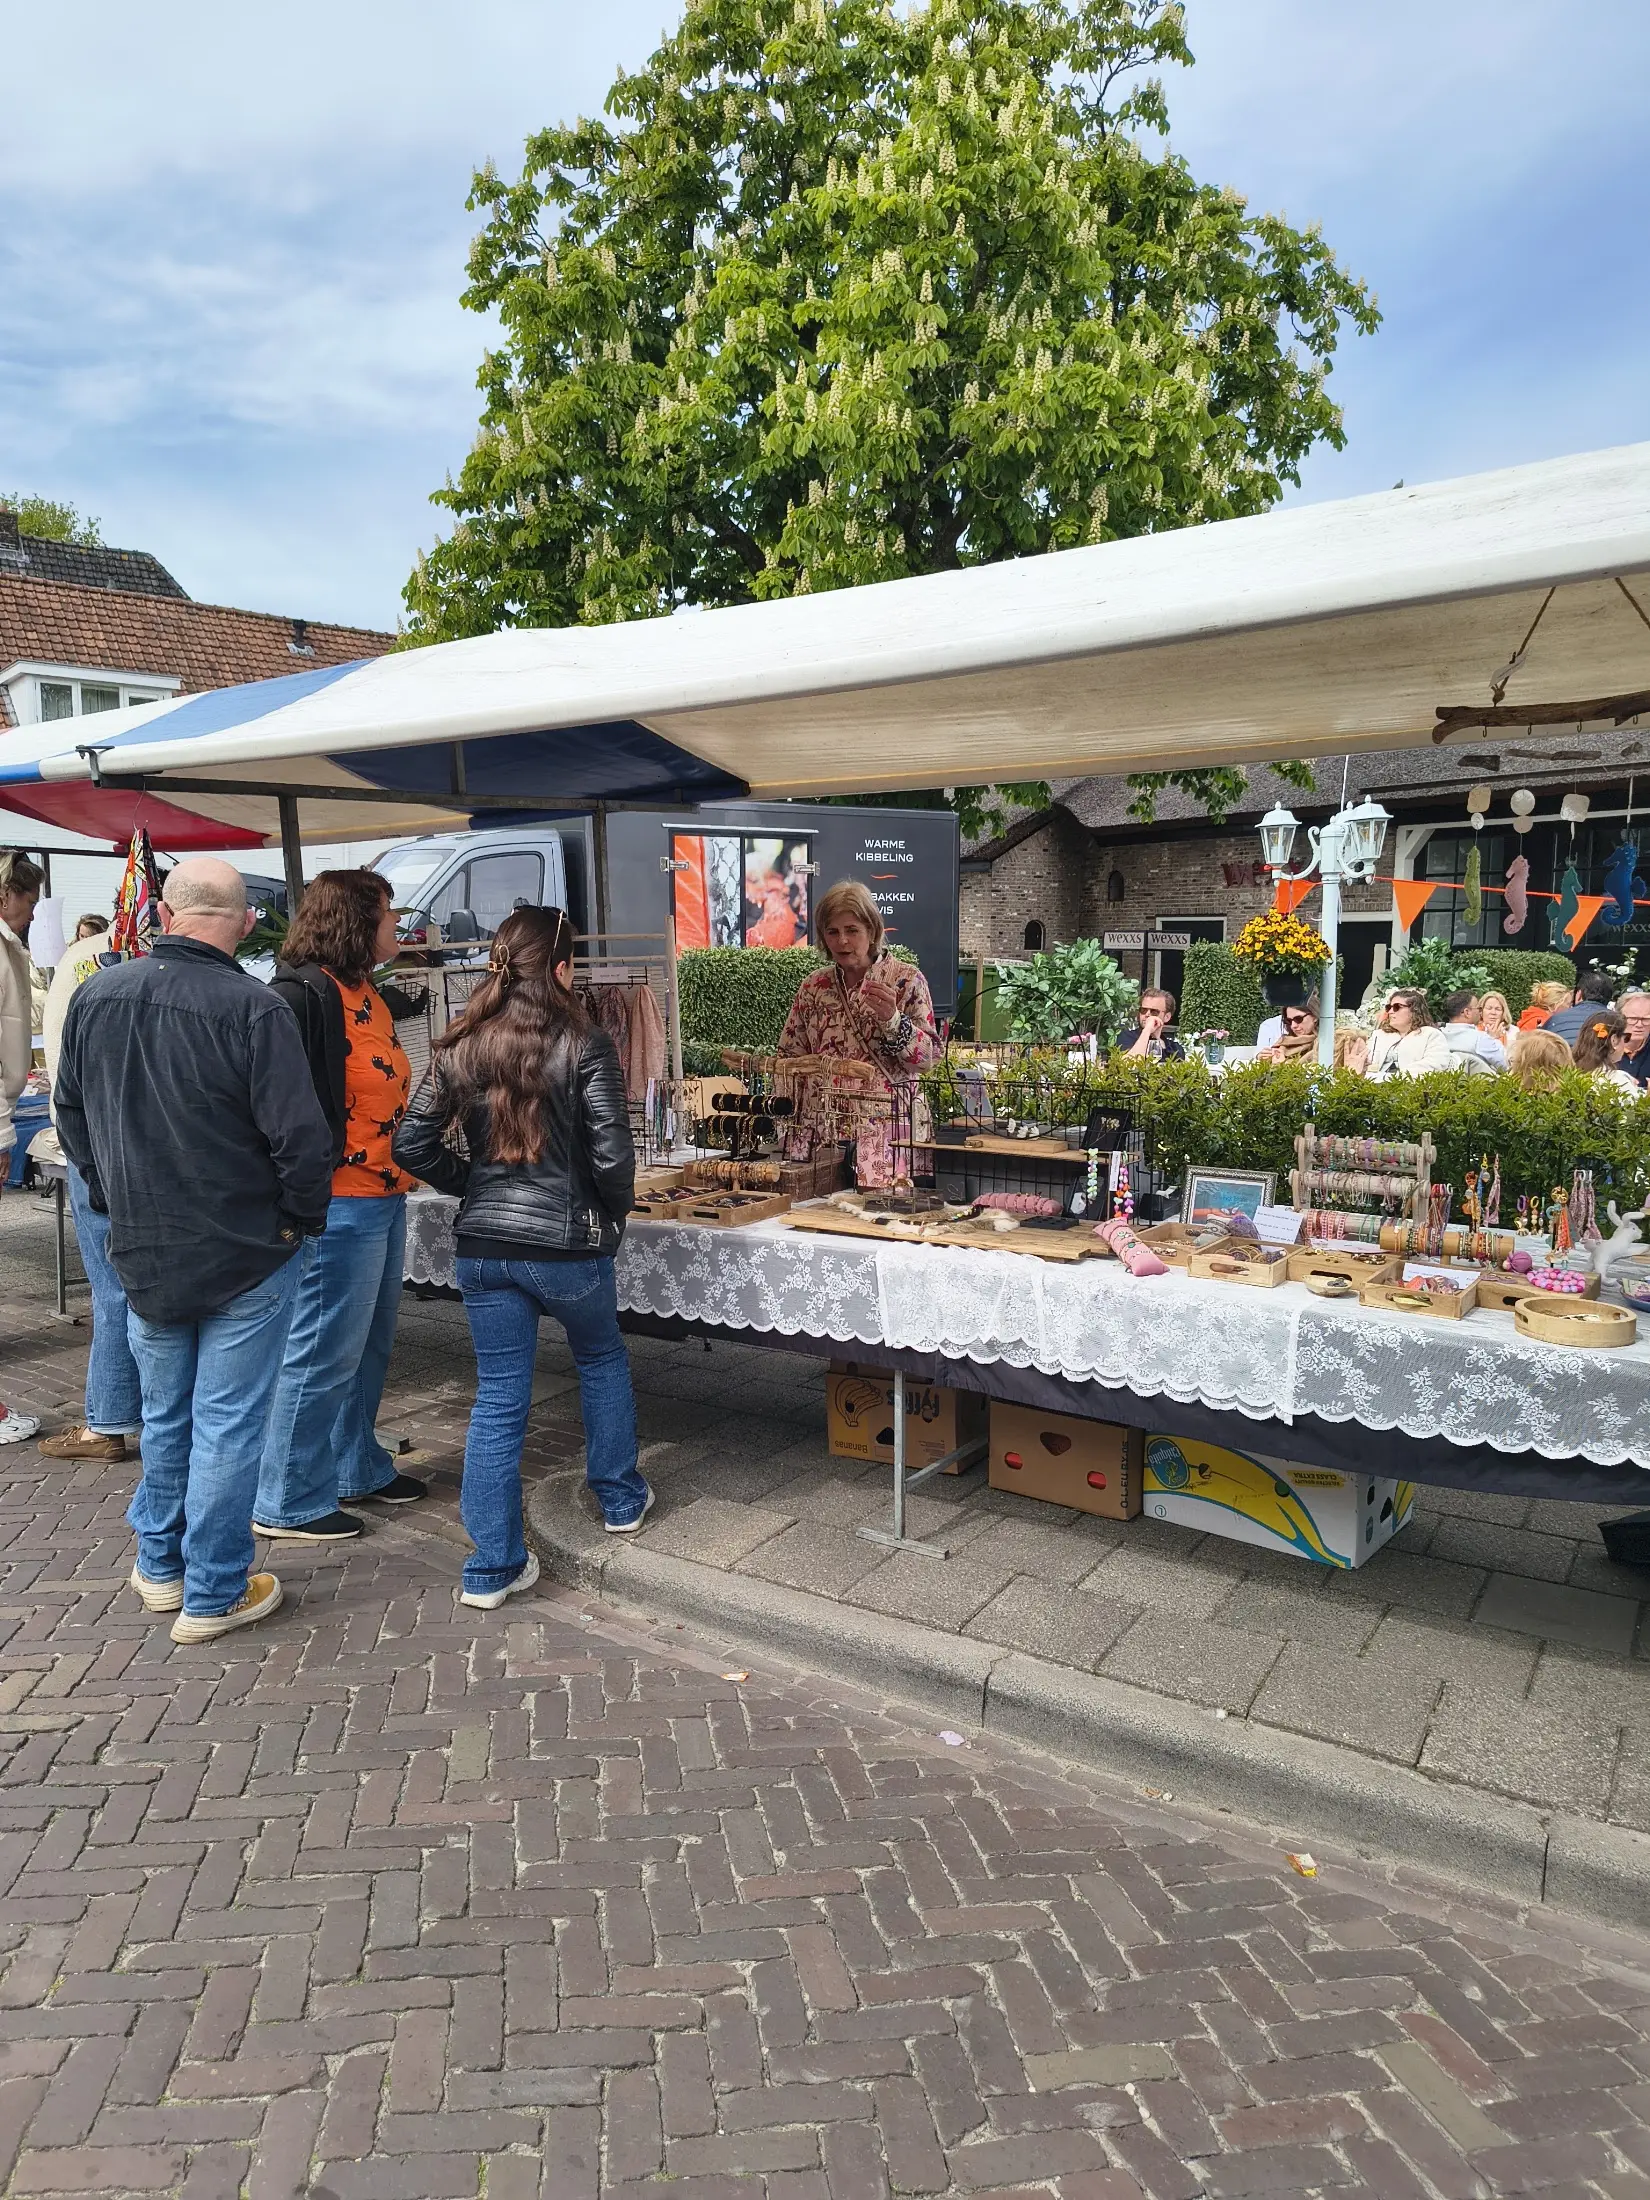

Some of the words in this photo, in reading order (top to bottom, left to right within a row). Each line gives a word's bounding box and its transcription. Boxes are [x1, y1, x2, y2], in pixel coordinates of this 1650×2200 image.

[865, 839, 905, 849] WARME
[855, 852, 914, 862] KIBBELING
[870, 892, 915, 902] BAKKEN
[1107, 933, 1142, 944] wexxs
[1151, 933, 1188, 944] wexxs
[834, 1440, 868, 1454] Bananas
[1148, 1446, 1181, 1465] Chiquita
